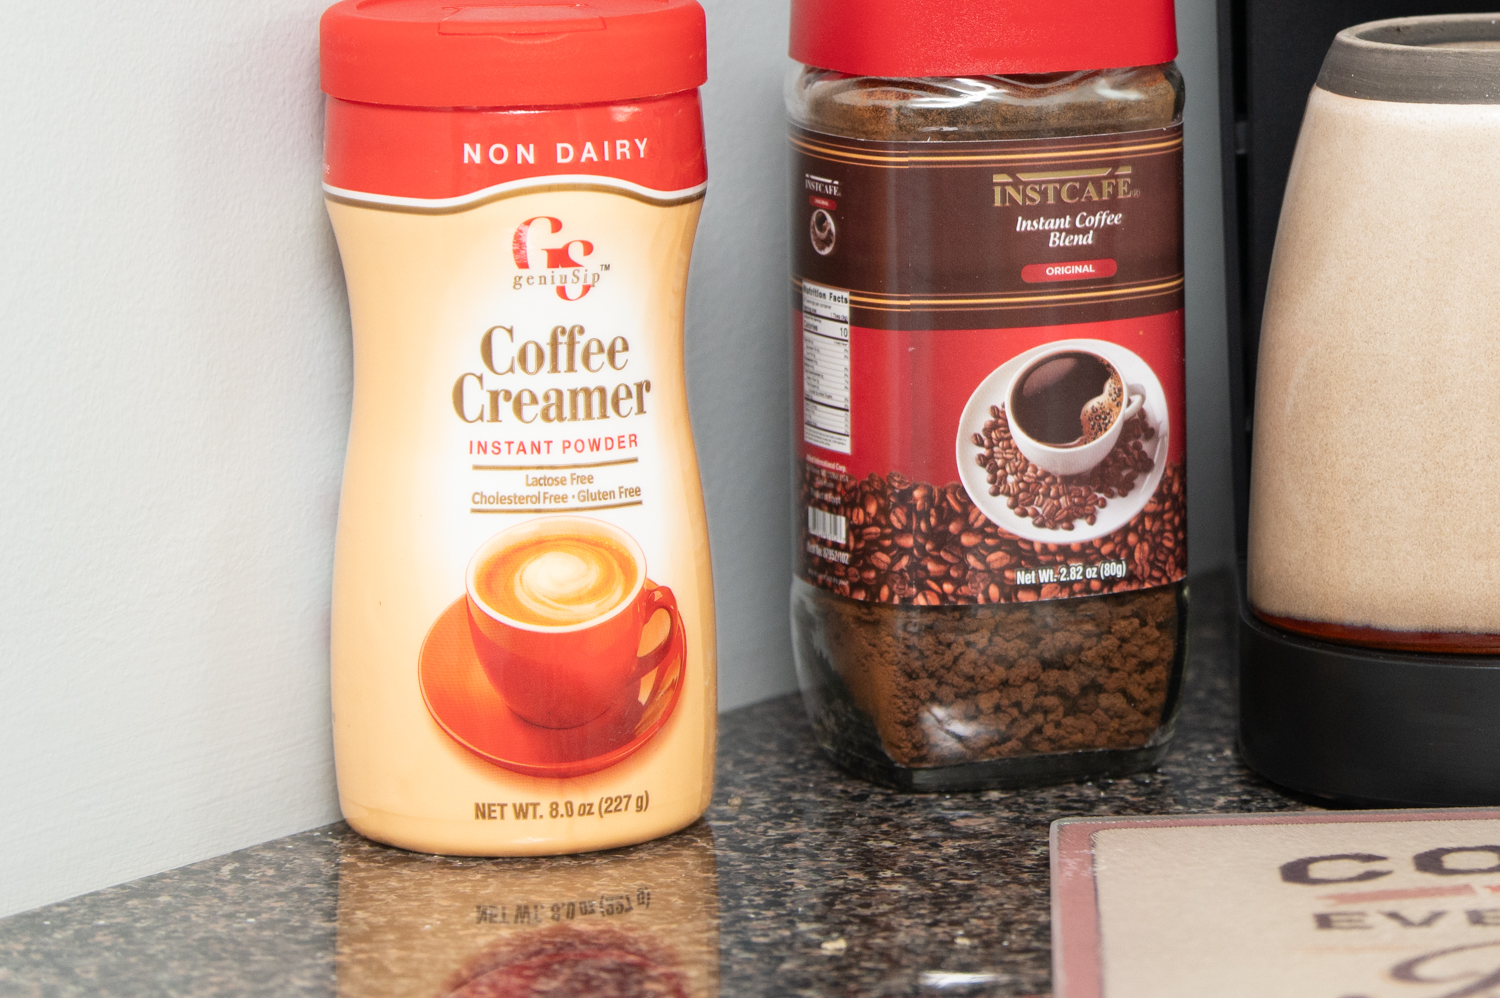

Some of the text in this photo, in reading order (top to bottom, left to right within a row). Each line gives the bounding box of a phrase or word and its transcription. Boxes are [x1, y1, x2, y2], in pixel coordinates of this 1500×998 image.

[462, 137, 648, 165] NON DAIRY
[1015, 210, 1122, 232] Instant Coffee
[1048, 230, 1094, 248] Blend
[1045, 264, 1096, 276] ORIGINAL
[803, 284, 827, 301] Nutrition
[828, 292, 849, 304] Facts
[839, 327, 848, 338] 10
[479, 324, 630, 376] Coffee
[451, 372, 652, 424] Creamer
[468, 432, 639, 456] INSTANT POWDER
[524, 472, 595, 488] Lactose Free
[470, 485, 642, 506] Cholesterol Free Gluten Free
[1015, 560, 1127, 585] Net Wt. 2.82 oz (80g)
[473, 789, 650, 821] NET WT. 8.0 oz (227 g)
